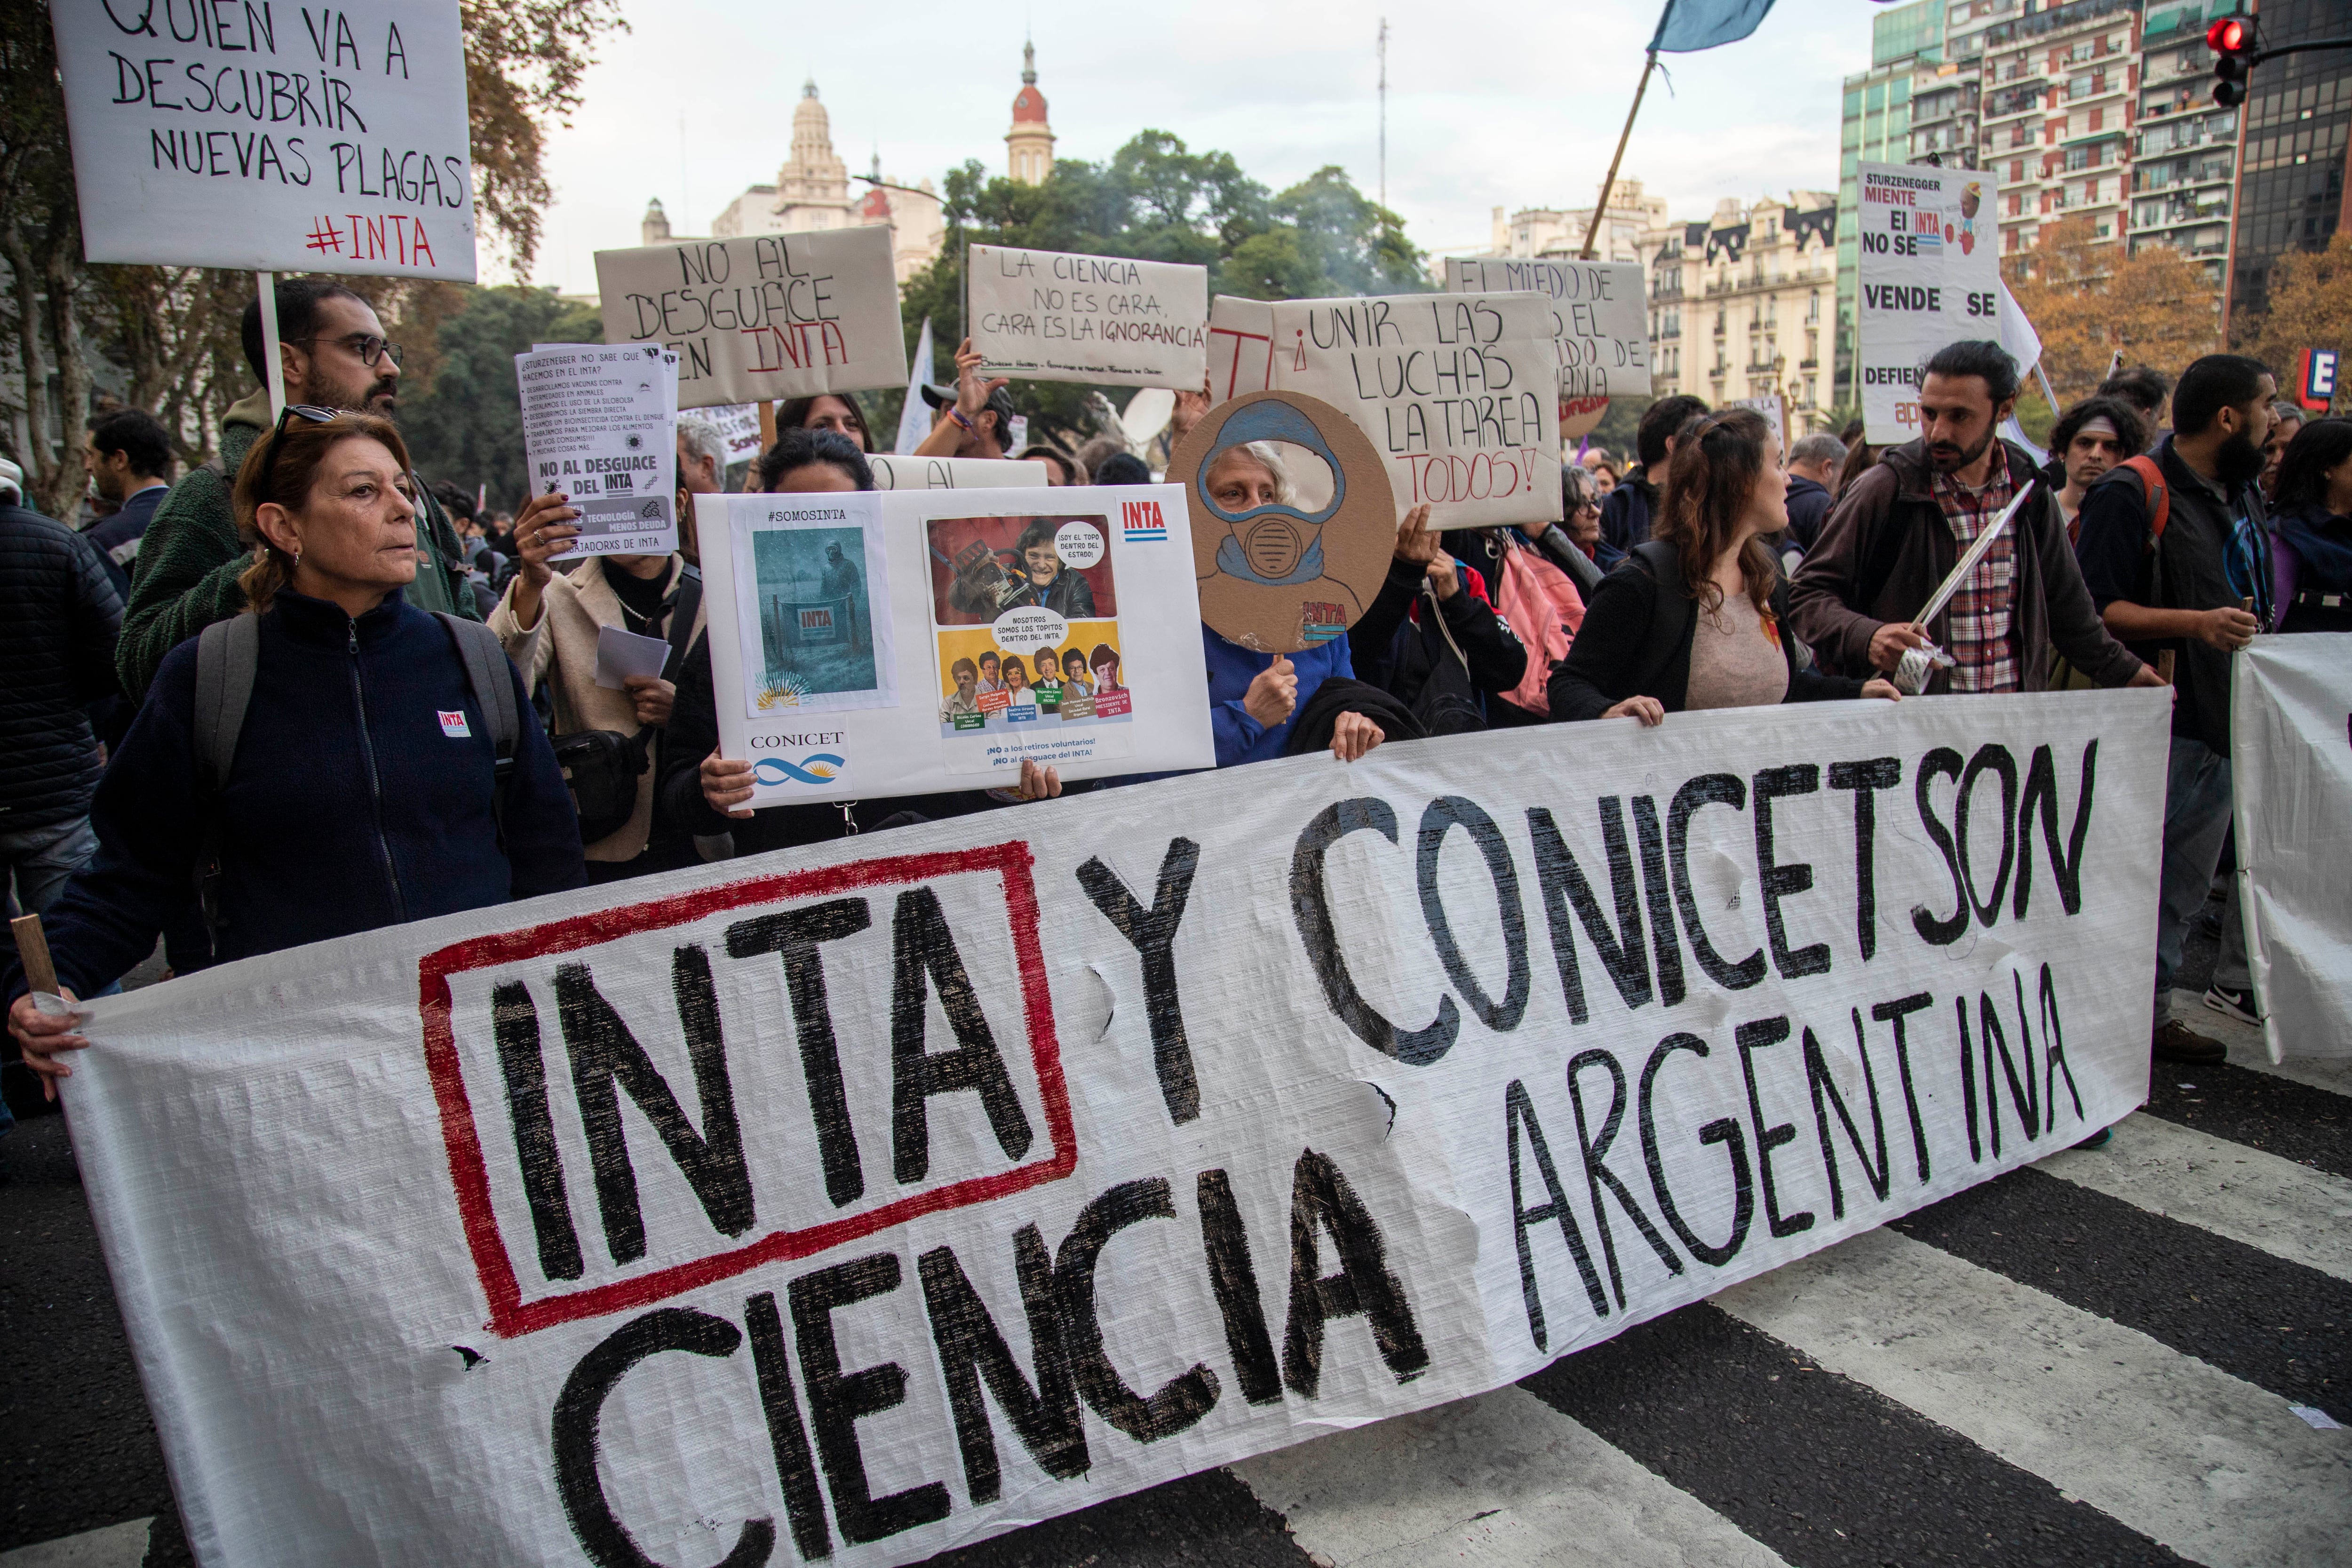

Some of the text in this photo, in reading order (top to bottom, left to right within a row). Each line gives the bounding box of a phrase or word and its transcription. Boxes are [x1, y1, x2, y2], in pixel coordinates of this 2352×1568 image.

[103, 0, 409, 80] QUIEN VA A
[108, 50, 367, 133] DESCUBRIR
[151, 128, 462, 208] NUEVAS PLAGAS
[1866, 173, 1940, 191] STURZENEGGER
[1865, 186, 1916, 207] MIENTE
[1915, 211, 1939, 235] INTA
[306, 215, 436, 267] #INTA
[1863, 232, 1918, 256] NO SE
[677, 237, 810, 285] NO AL
[1054, 256, 1141, 285] CIENCIA
[1587, 267, 1614, 302] DE
[625, 275, 840, 340] DESGUACE
[1034, 287, 1065, 311] NO
[1072, 291, 1098, 313] ES
[1865, 284, 1996, 317] VENDE SE
[982, 313, 1035, 336] CARA
[1044, 316, 1067, 339] ES
[1071, 317, 1094, 340] LA
[1433, 300, 1503, 344] LAS
[582, 354, 594, 362] NO
[740, 321, 849, 373] INTA
[1614, 339, 1645, 367] DE
[522, 366, 602, 382] HACEMOS EN EL INTA?
[1351, 344, 1513, 399] LUCHAS
[2312, 353, 2335, 393] E
[526, 382, 571, 394] DESARROLLAMOS
[527, 391, 565, 403] ENFERMEDADES
[529, 401, 559, 412] INSTALAMOS
[530, 420, 553, 430] CREAMOS
[564, 416, 609, 425] BIOINSECTICIDA
[1385, 403, 1429, 452] LA
[1432, 391, 1542, 448] TAREA
[531, 428, 563, 438] TRABAJAMOS
[537, 446, 556, 456] MUCHAS
[540, 455, 657, 478] NO AL DESGUACE
[1396, 448, 1537, 503] TODOS!
[573, 473, 633, 495] DEL INTA
[588, 510, 636, 523] TECNOLOGÍA
[609, 520, 667, 532] MENOS DEUDA
[768, 509, 847, 522] #SOMOSINTA
[1122, 501, 1166, 529] INTA
[623, 539, 634, 549] DE
[639, 537, 660, 548] INTA
[801, 610, 832, 628] INTA
[1013, 616, 1046, 624] NOSOTROS
[1303, 602, 1347, 624] INTA
[1095, 692, 1128, 703] Bronzovich
[1096, 700, 1120, 709] PRESIDENTE
[440, 713, 465, 726] INTA
[751, 732, 844, 748] CONICET
[987, 746, 1002, 755] ¡NO
[1051, 738, 1096, 748] voluntarios!
[993, 757, 1008, 766] ¡NO
[491, 738, 2099, 1281] INTA Y CONICET SON
[552, 962, 2084, 1568] CIENCIA ARGENTINA
